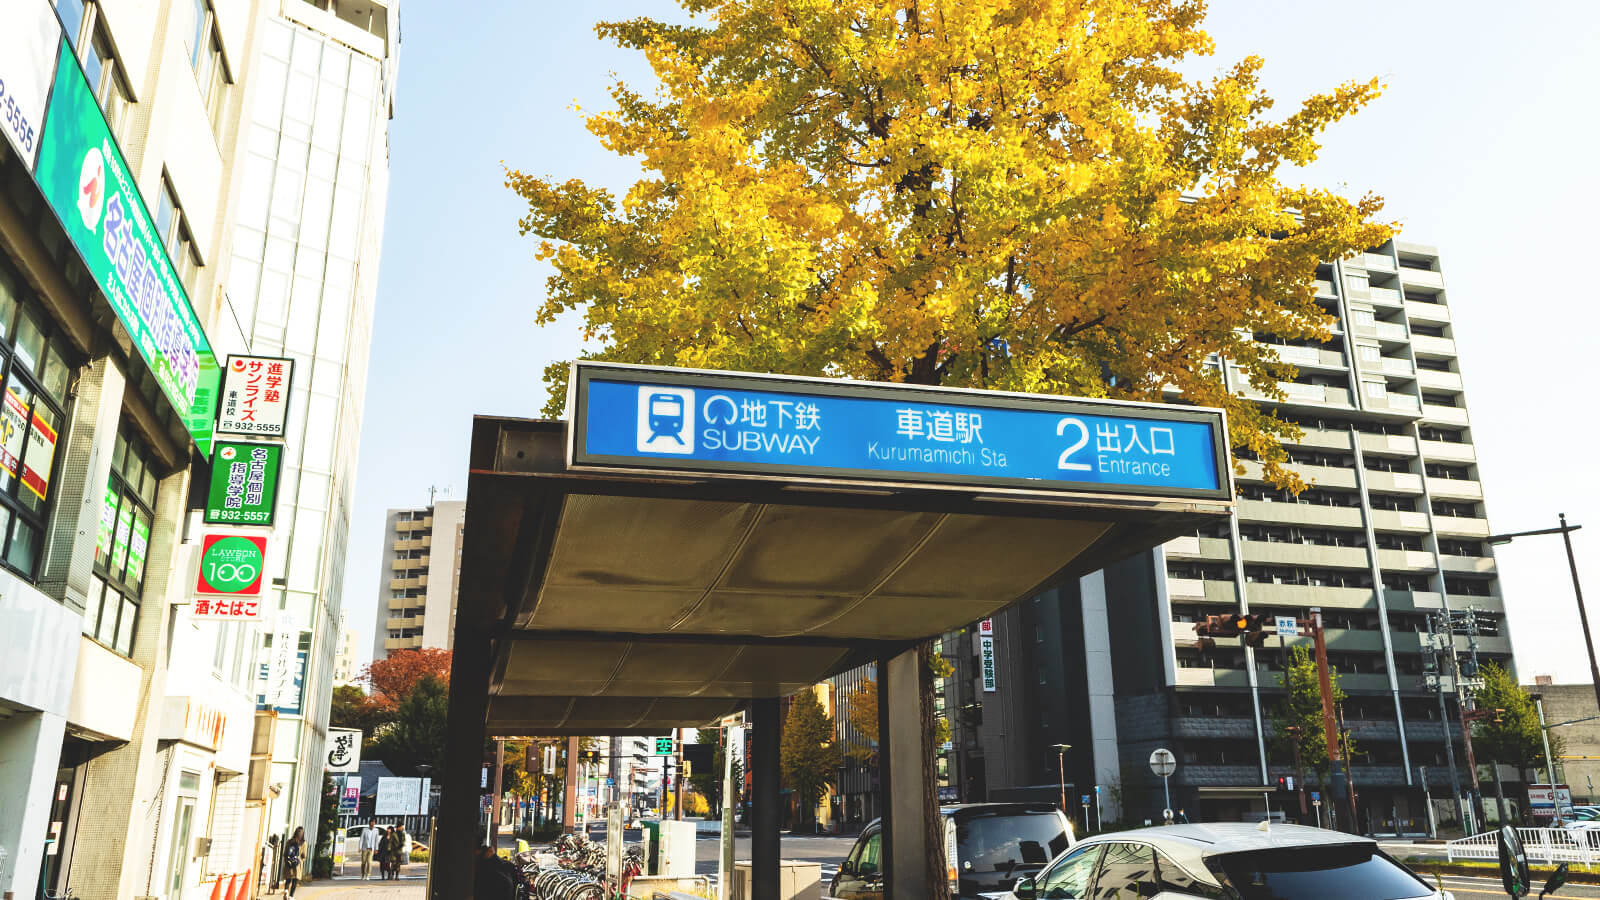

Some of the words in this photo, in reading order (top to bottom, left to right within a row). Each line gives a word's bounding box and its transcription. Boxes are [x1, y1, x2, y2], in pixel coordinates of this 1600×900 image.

[104, 192, 200, 406] 名古屋個別指導学院
[240, 360, 264, 422] サンライズ
[264, 362, 284, 403] 進学塾
[226, 390, 238, 416] 車道校
[740, 397, 821, 431] 地下鉄
[234, 422, 281, 432] 932-5555
[702, 428, 821, 455] SUBWAY
[895, 407, 984, 444] 車道駅
[1096, 421, 1175, 456] 出入口
[867, 440, 975, 465] Kurumamichi
[980, 446, 1008, 468] Sta
[1056, 417, 1092, 471] 2
[244, 448, 269, 505] 名古屋個別
[1098, 454, 1171, 477] Entrance
[225, 462, 247, 509] 指導学院
[221, 510, 270, 521] 932-5557
[212, 548, 257, 558] LAWSON
[209, 562, 256, 583] 100
[195, 599, 258, 616] 酒・たばこ
[983, 640, 994, 688] 中学受験部
